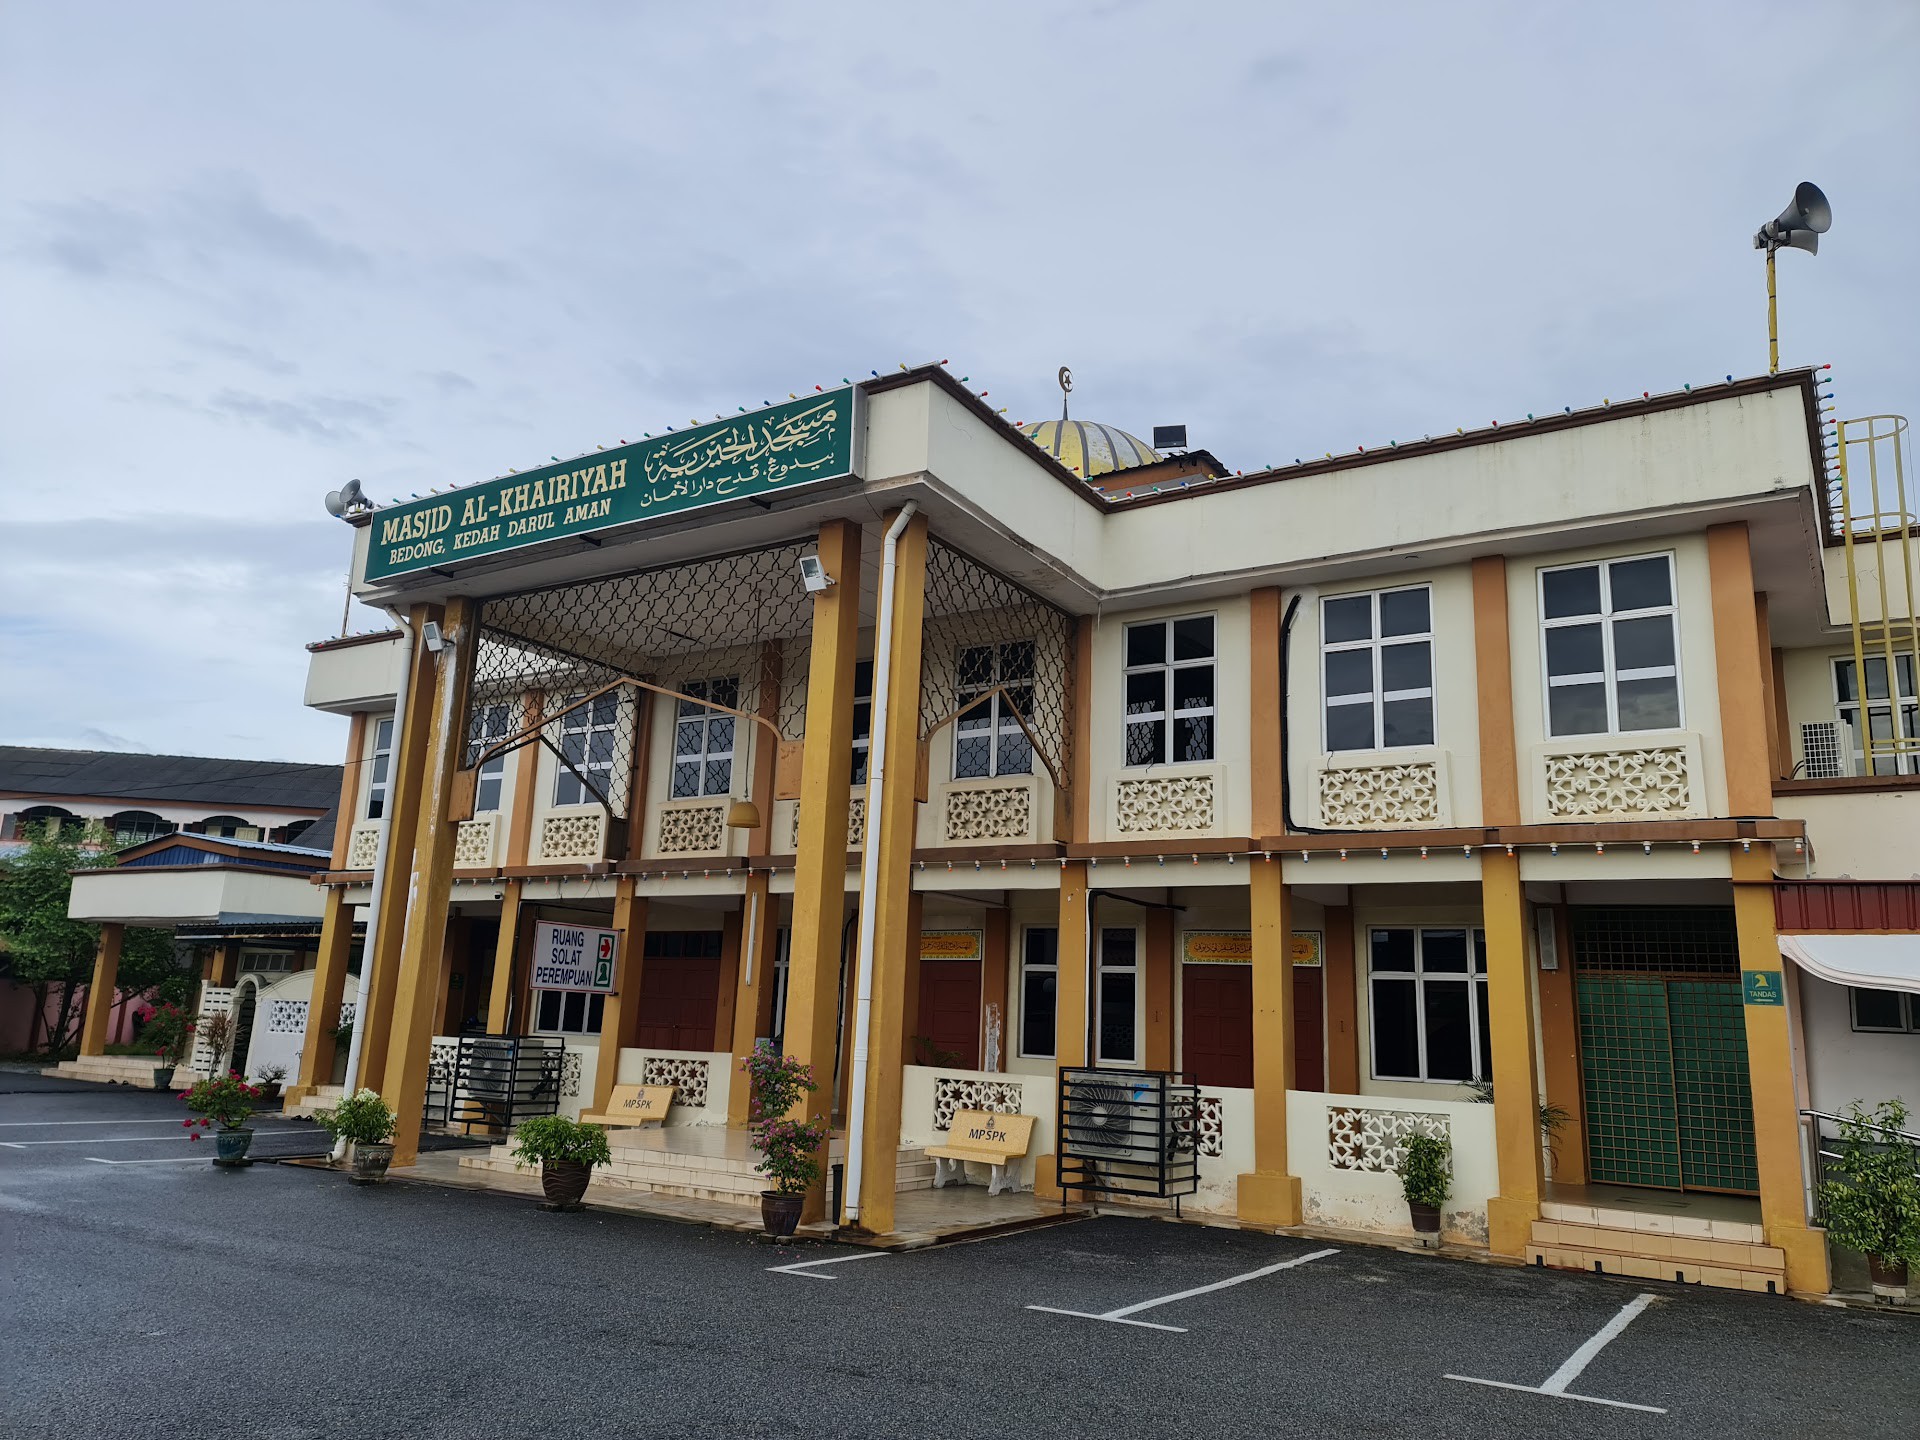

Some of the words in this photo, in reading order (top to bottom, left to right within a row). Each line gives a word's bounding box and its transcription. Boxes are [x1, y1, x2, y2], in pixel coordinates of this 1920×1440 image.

[380, 504, 453, 545] MASJID
[460, 459, 627, 526] AL-KHAIRIYAH
[389, 538, 446, 565] BEDONG,
[453, 525, 500, 550] KEDAH
[507, 512, 555, 537] DARUL
[563, 498, 611, 525] AMAN
[552, 928, 584, 947] RUANG
[551, 948, 582, 966] SOLAT
[536, 967, 592, 986] PEREMPUAN
[623, 1099, 652, 1109] MPSPK
[968, 1128, 1007, 1142] MPSPK
